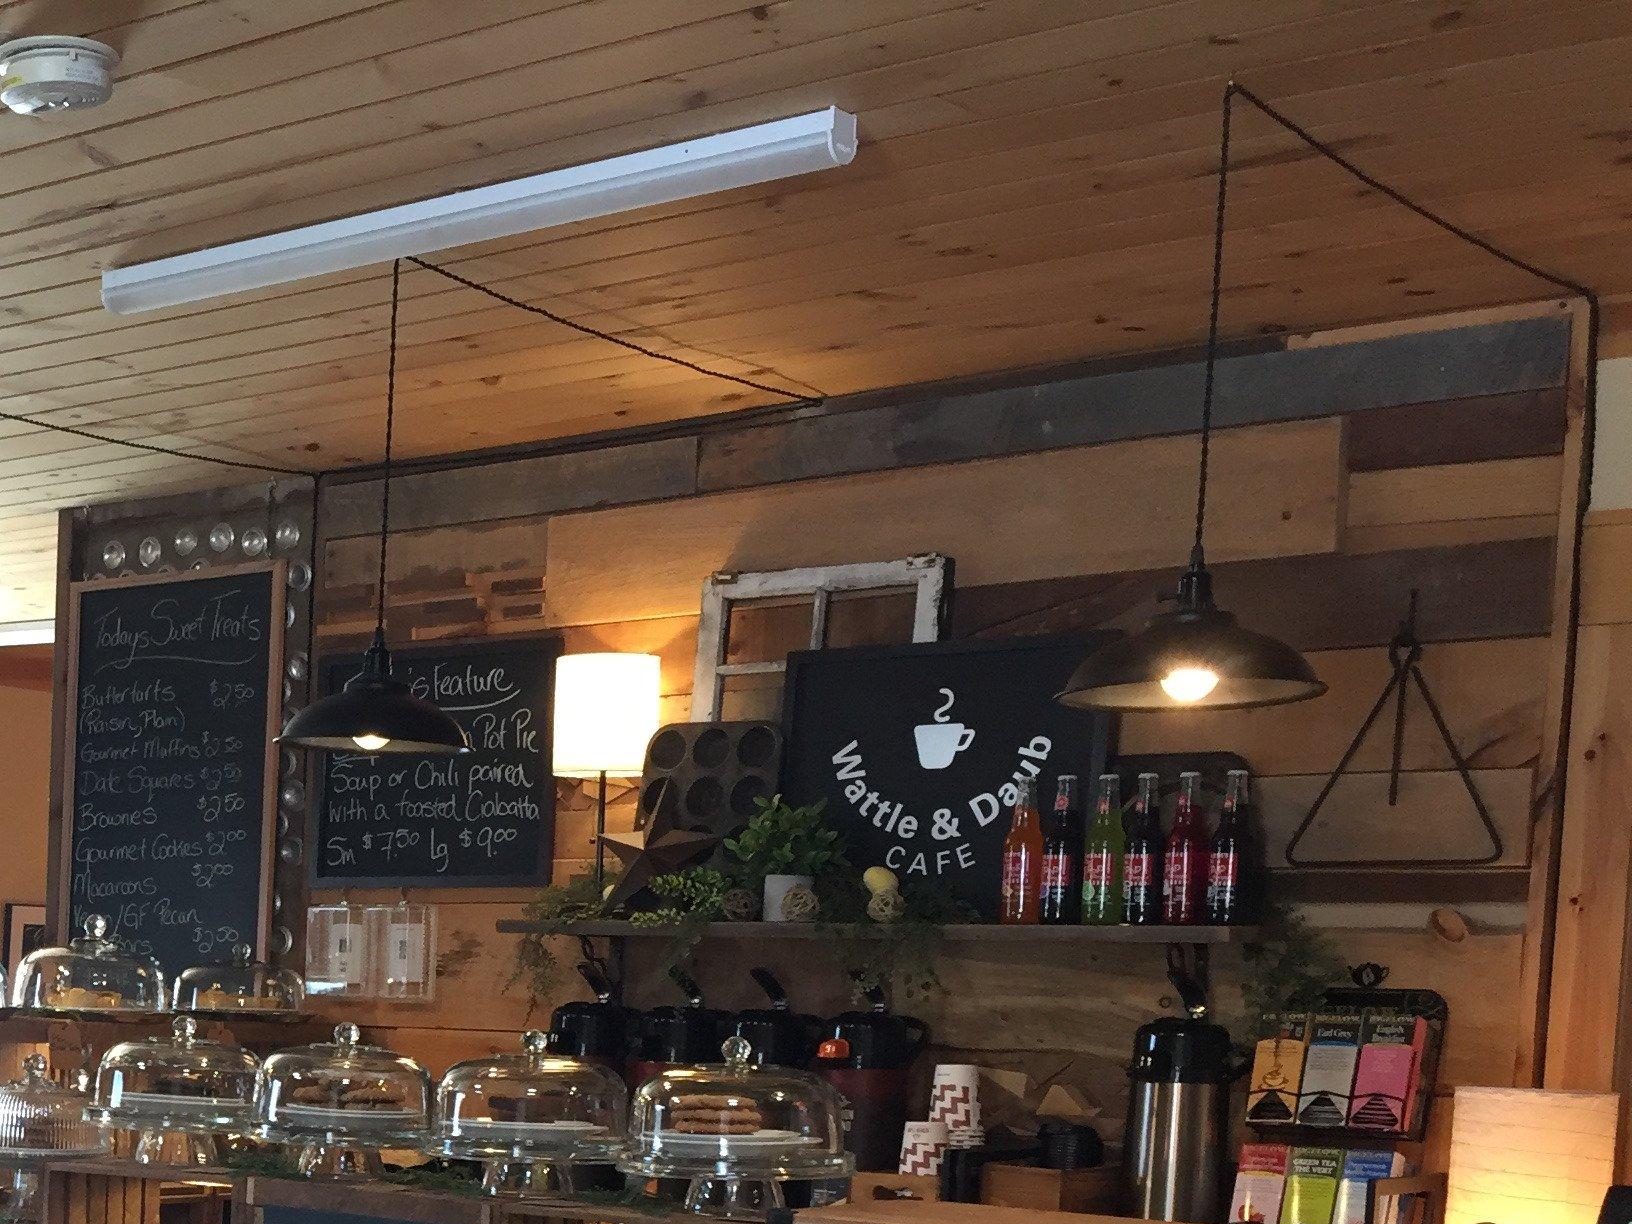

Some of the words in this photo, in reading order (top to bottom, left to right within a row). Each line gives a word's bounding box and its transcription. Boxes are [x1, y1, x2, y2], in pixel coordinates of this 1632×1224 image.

[151, 599, 208, 646] Sweet
[209, 589, 261, 641] Treats
[434, 662, 514, 700] Feature
[473, 713, 506, 750] Pot
[511, 708, 539, 753] Pie
[330, 762, 382, 801] Soup
[388, 769, 408, 787] or
[414, 758, 460, 790] Chili
[468, 758, 535, 793] paired
[831, 738, 919, 839] Wattle
[930, 807, 962, 841] &
[969, 734, 1053, 828] Daub
[373, 804, 390, 821] a
[393, 789, 463, 822] toasted
[326, 836, 357, 867] Sm
[885, 843, 977, 877] CAFE
[153, 897, 206, 926] Pecan
